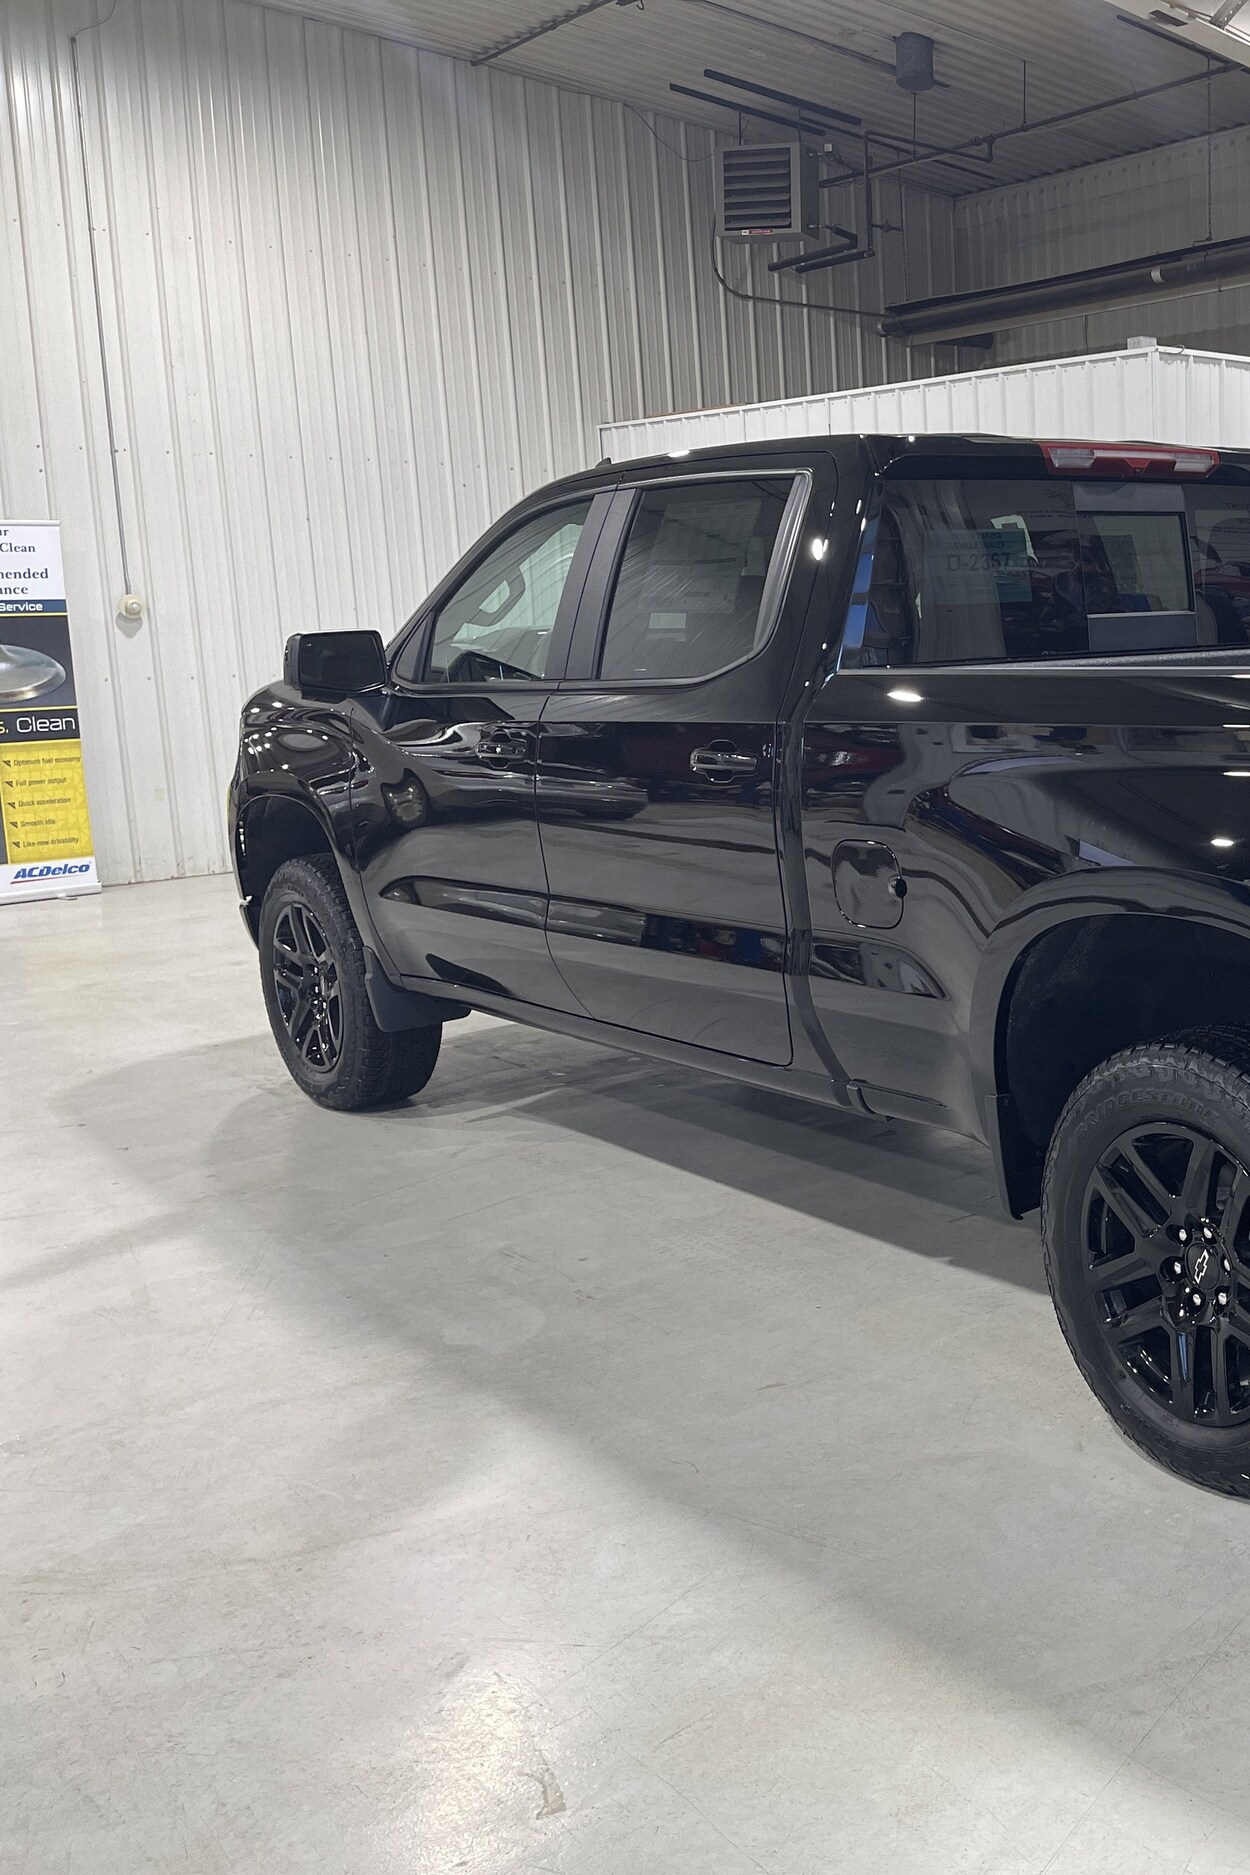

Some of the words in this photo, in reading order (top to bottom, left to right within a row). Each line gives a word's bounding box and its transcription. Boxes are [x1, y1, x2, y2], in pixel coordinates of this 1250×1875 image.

[0, 542, 36, 553] Clean
[16, 716, 76, 733] Clean
[13, 863, 91, 879] ACDelco
